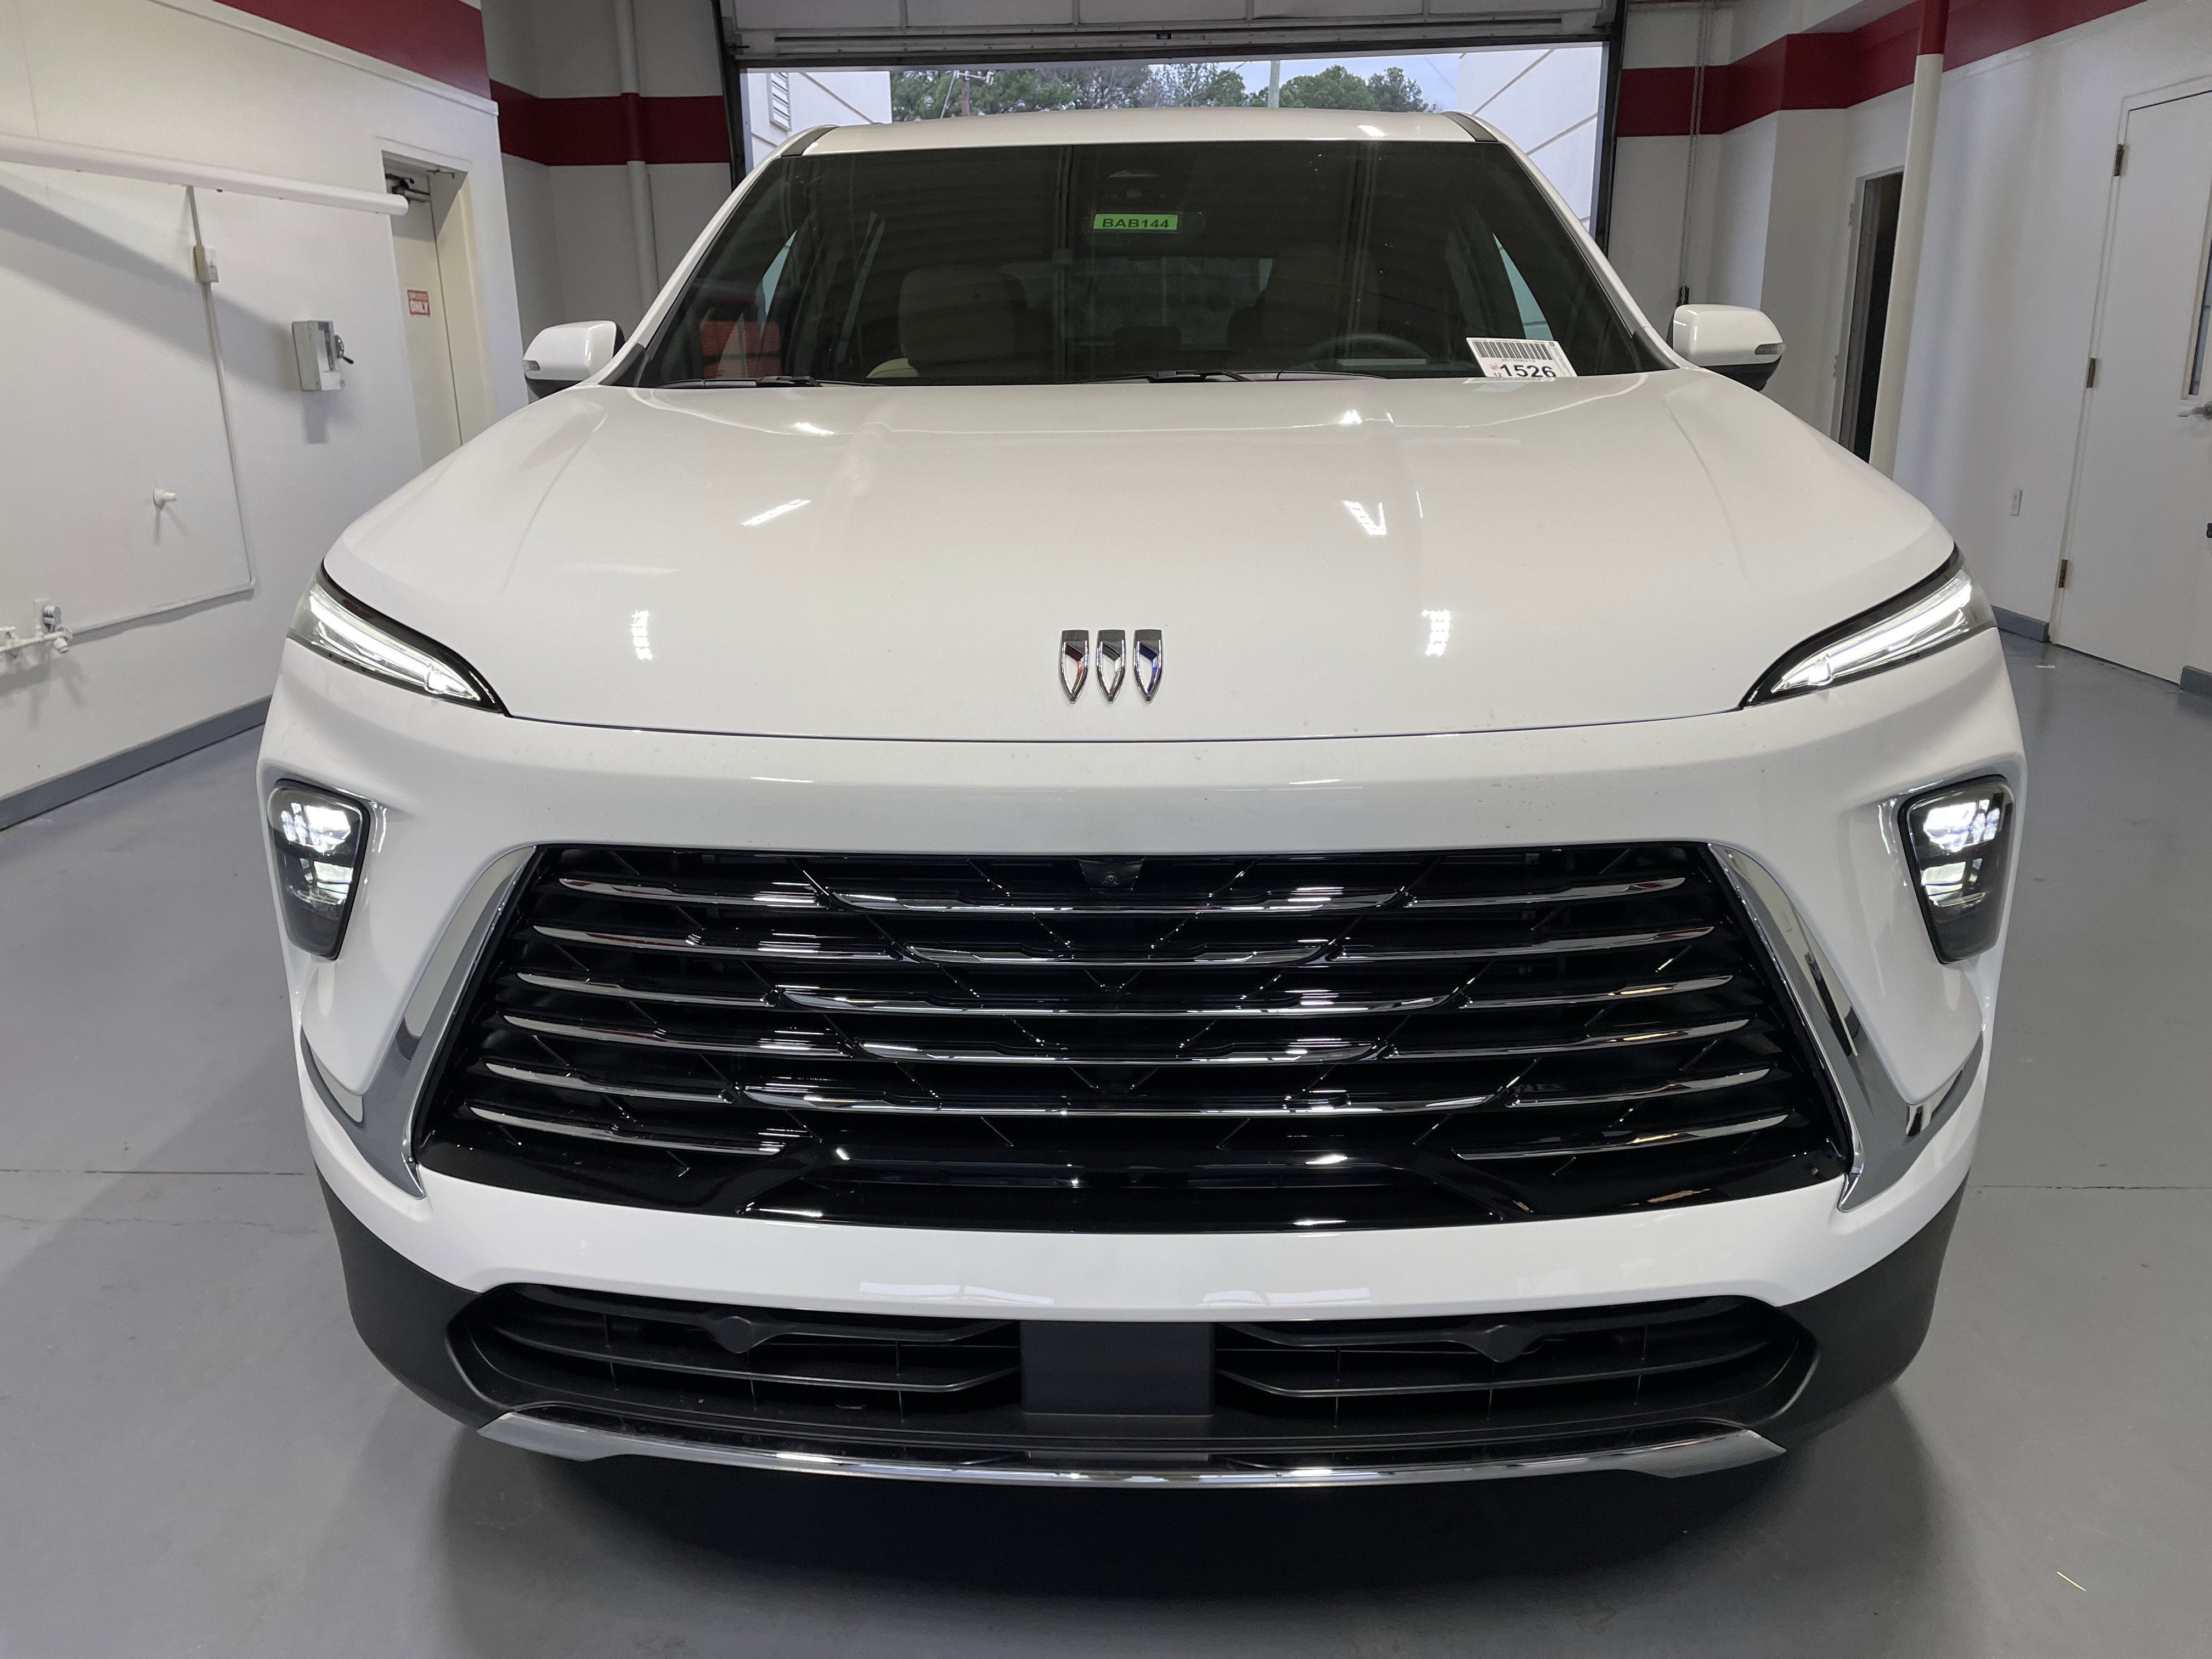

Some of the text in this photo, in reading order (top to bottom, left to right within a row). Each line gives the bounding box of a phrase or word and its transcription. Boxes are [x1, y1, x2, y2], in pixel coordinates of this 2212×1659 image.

[1102, 218, 1169, 228] BAB144
[410, 301, 428, 313] ONLY
[1500, 364, 1557, 377] 1526
